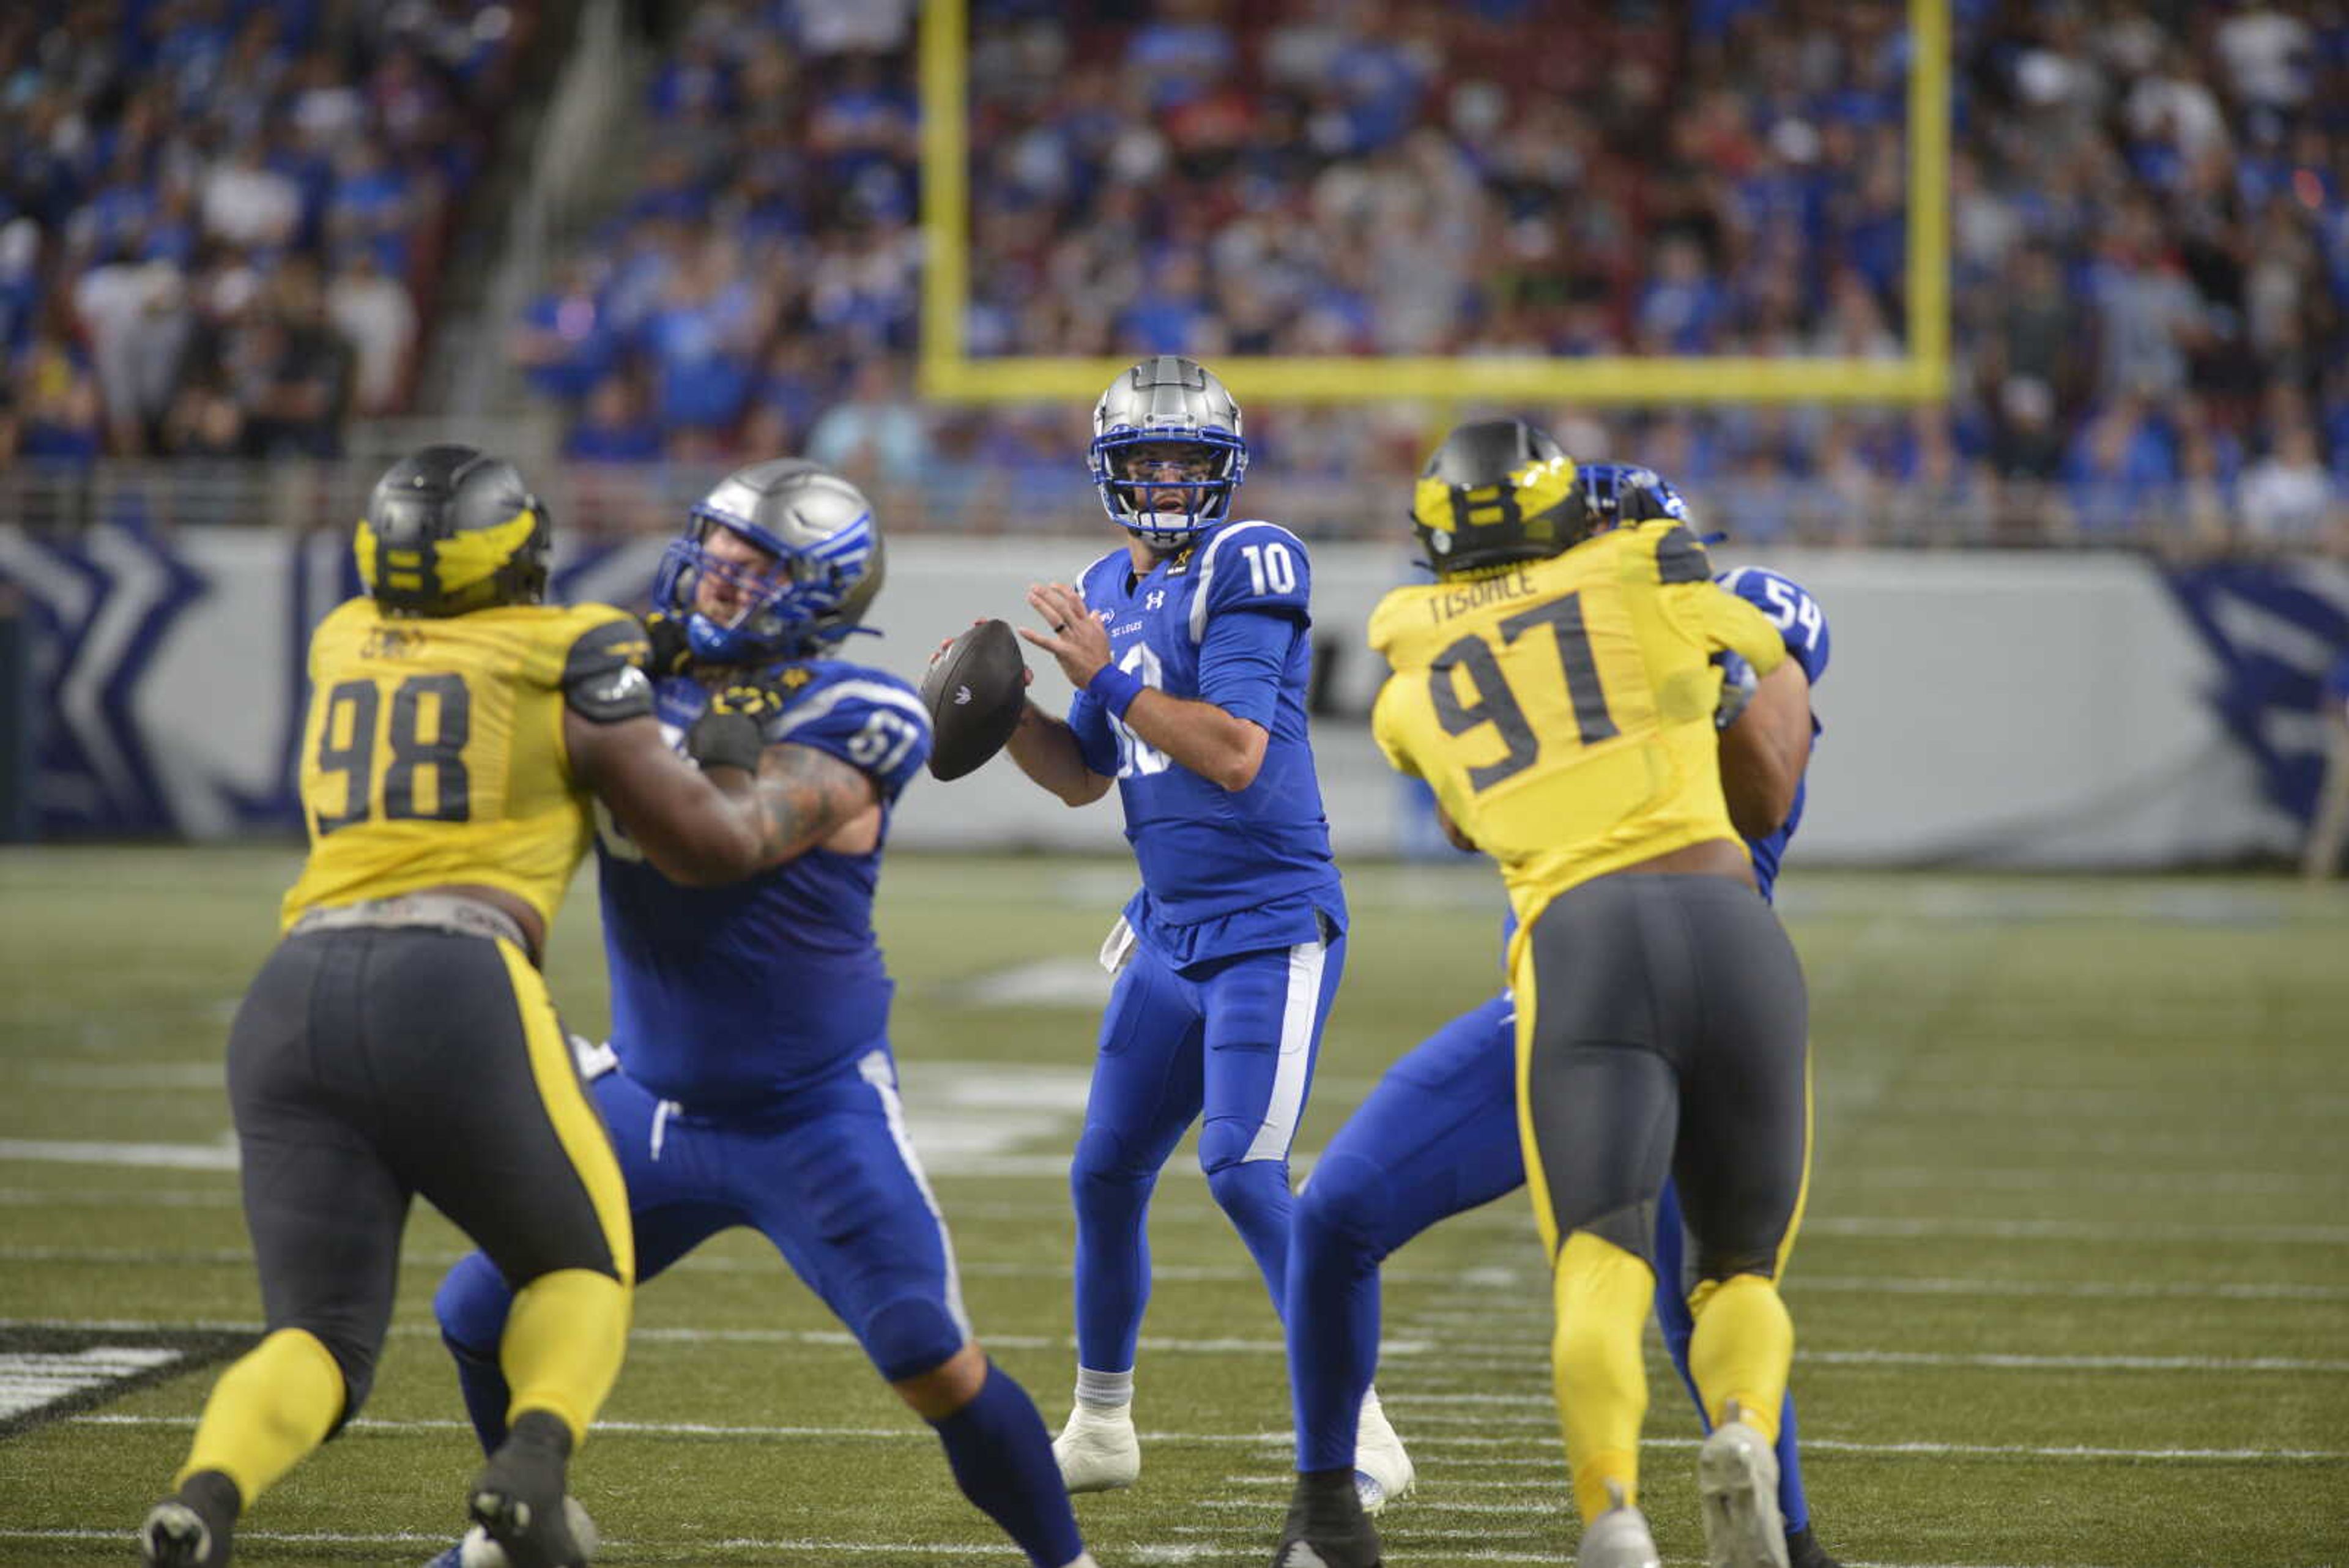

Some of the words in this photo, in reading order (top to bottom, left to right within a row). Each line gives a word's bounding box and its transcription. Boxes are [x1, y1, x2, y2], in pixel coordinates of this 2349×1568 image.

[1242, 542, 1296, 596] 10
[1765, 577, 1822, 652] 54
[1429, 590, 1622, 795] 97
[317, 673, 470, 838] 98
[847, 710, 918, 776] 51
